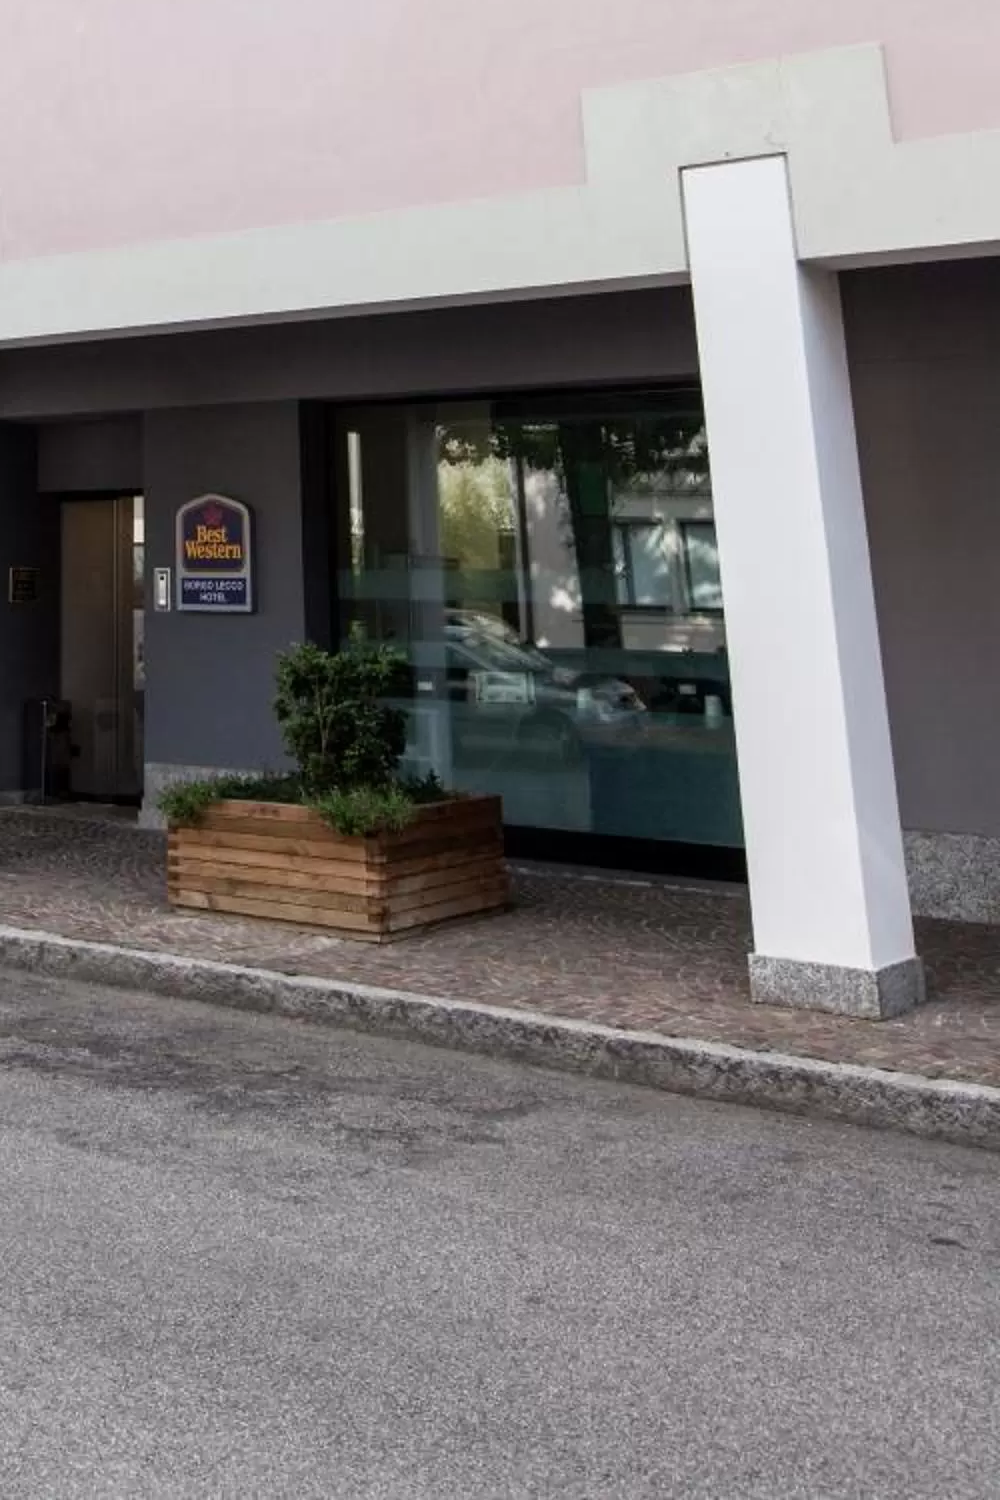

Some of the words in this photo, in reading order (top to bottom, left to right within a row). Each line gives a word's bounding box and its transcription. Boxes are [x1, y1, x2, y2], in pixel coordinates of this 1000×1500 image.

[196, 525, 227, 542] Best
[185, 541, 241, 559] Western
[200, 592, 226, 602] HOTEL
